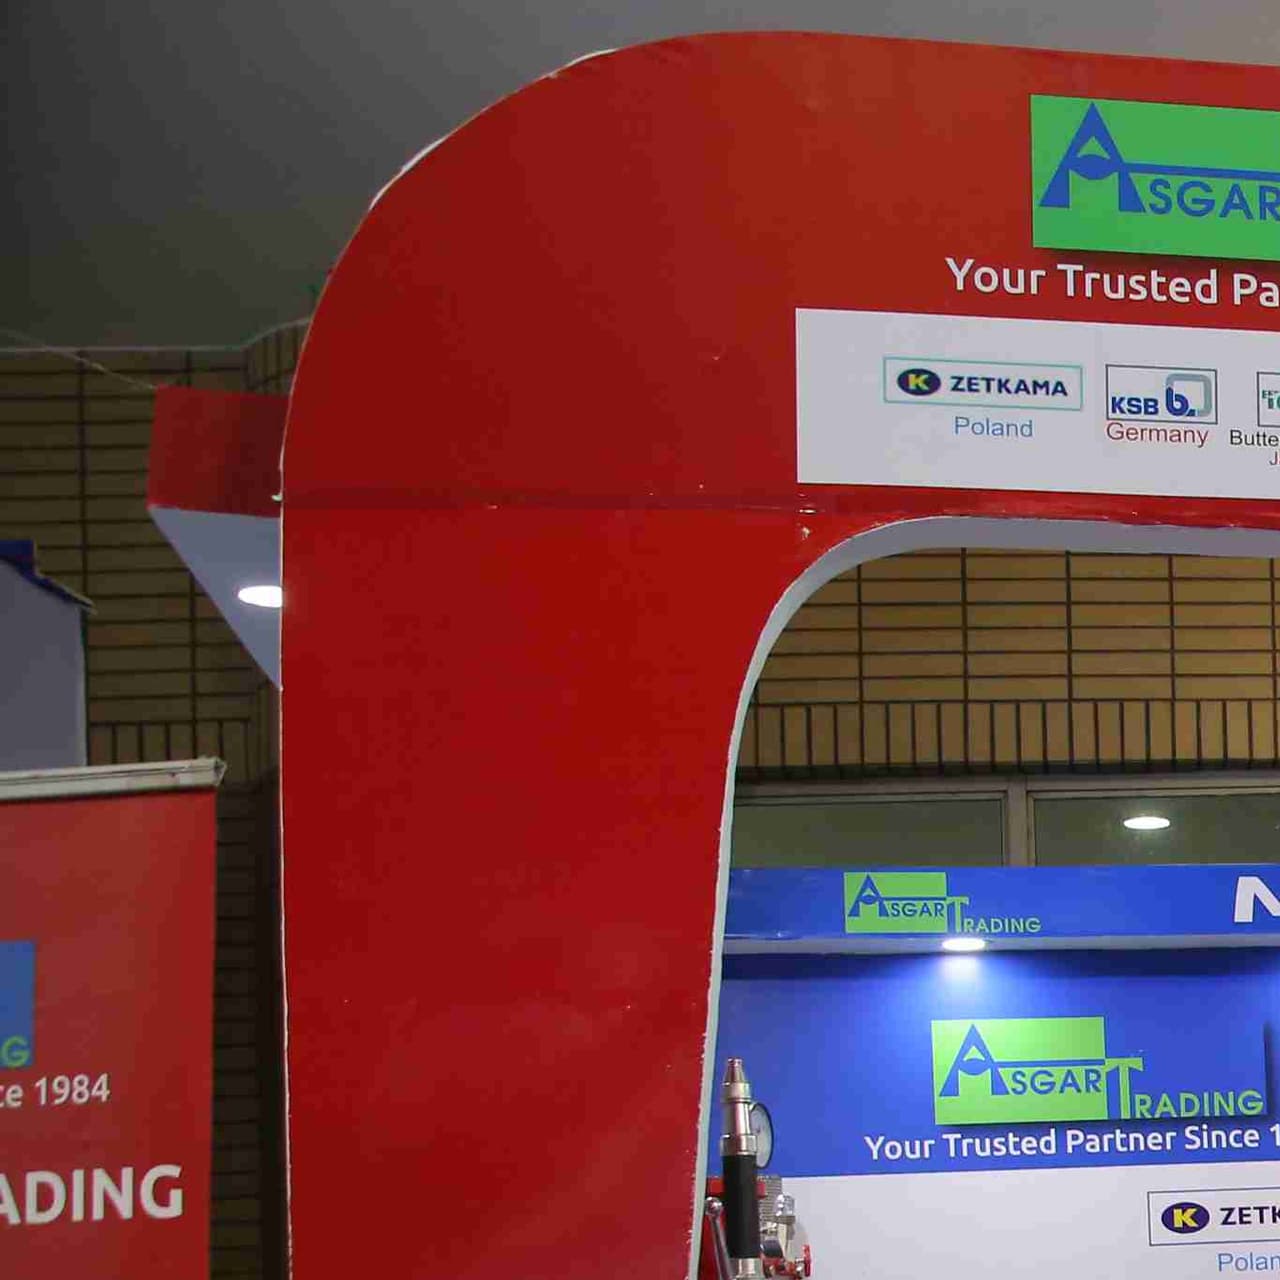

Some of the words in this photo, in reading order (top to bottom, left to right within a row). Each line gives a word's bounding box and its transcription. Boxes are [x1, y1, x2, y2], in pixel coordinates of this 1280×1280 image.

[945, 257, 1046, 297] Your
[1056, 263, 1218, 306] Trusted
[950, 375, 1068, 397] ZETKAMA
[1111, 396, 1159, 415] KSB
[954, 416, 1033, 438] Poland
[1106, 422, 1208, 448] Germany
[848, 874, 945, 919] ASGAR
[946, 896, 1041, 934] TRADING
[938, 1024, 1102, 1098] ASGAR
[1104, 1056, 1264, 1119] TRADING
[34, 1072, 111, 1107] 1984
[865, 1133, 936, 1162] Your
[942, 1129, 1058, 1158] Trusted
[1067, 1125, 1177, 1155] Partner
[1184, 1123, 1261, 1152] Since
